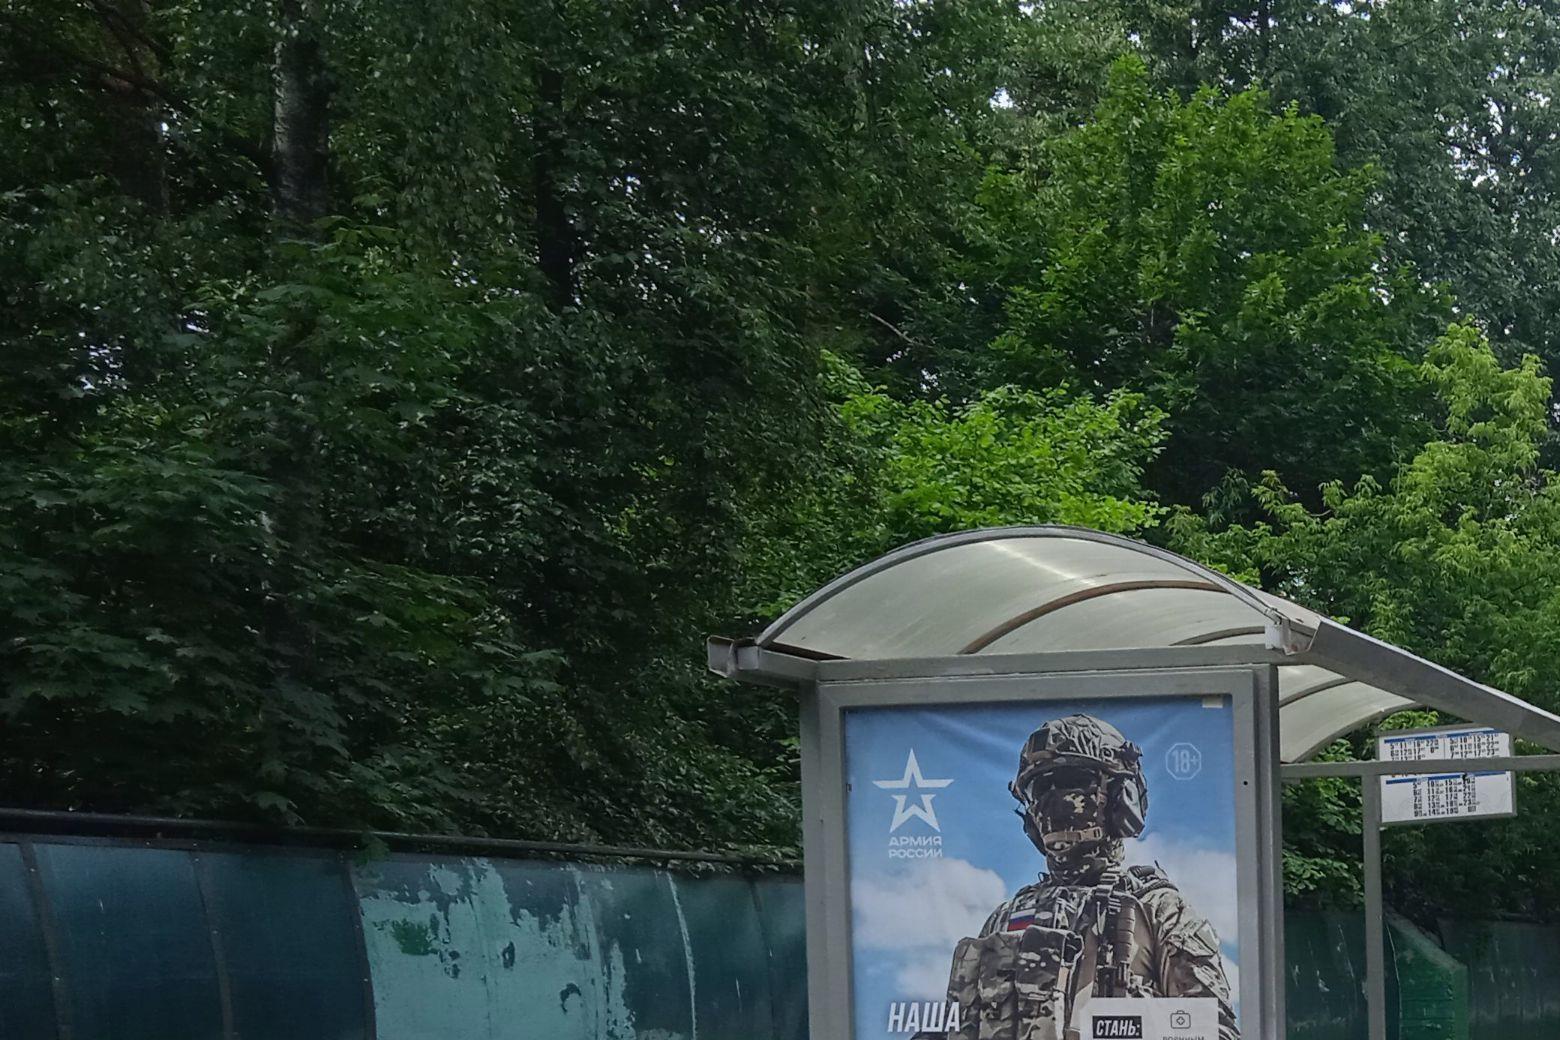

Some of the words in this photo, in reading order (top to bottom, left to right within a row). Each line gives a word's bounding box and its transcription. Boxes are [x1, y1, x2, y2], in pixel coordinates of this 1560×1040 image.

[1171, 750, 1200, 772] 18+
[888, 836, 942, 847] АРМИЯ
[888, 848, 943, 858] РОССИИ
[887, 1001, 961, 1033] НАША
[1096, 1019, 1140, 1037] СТАНЬ:
